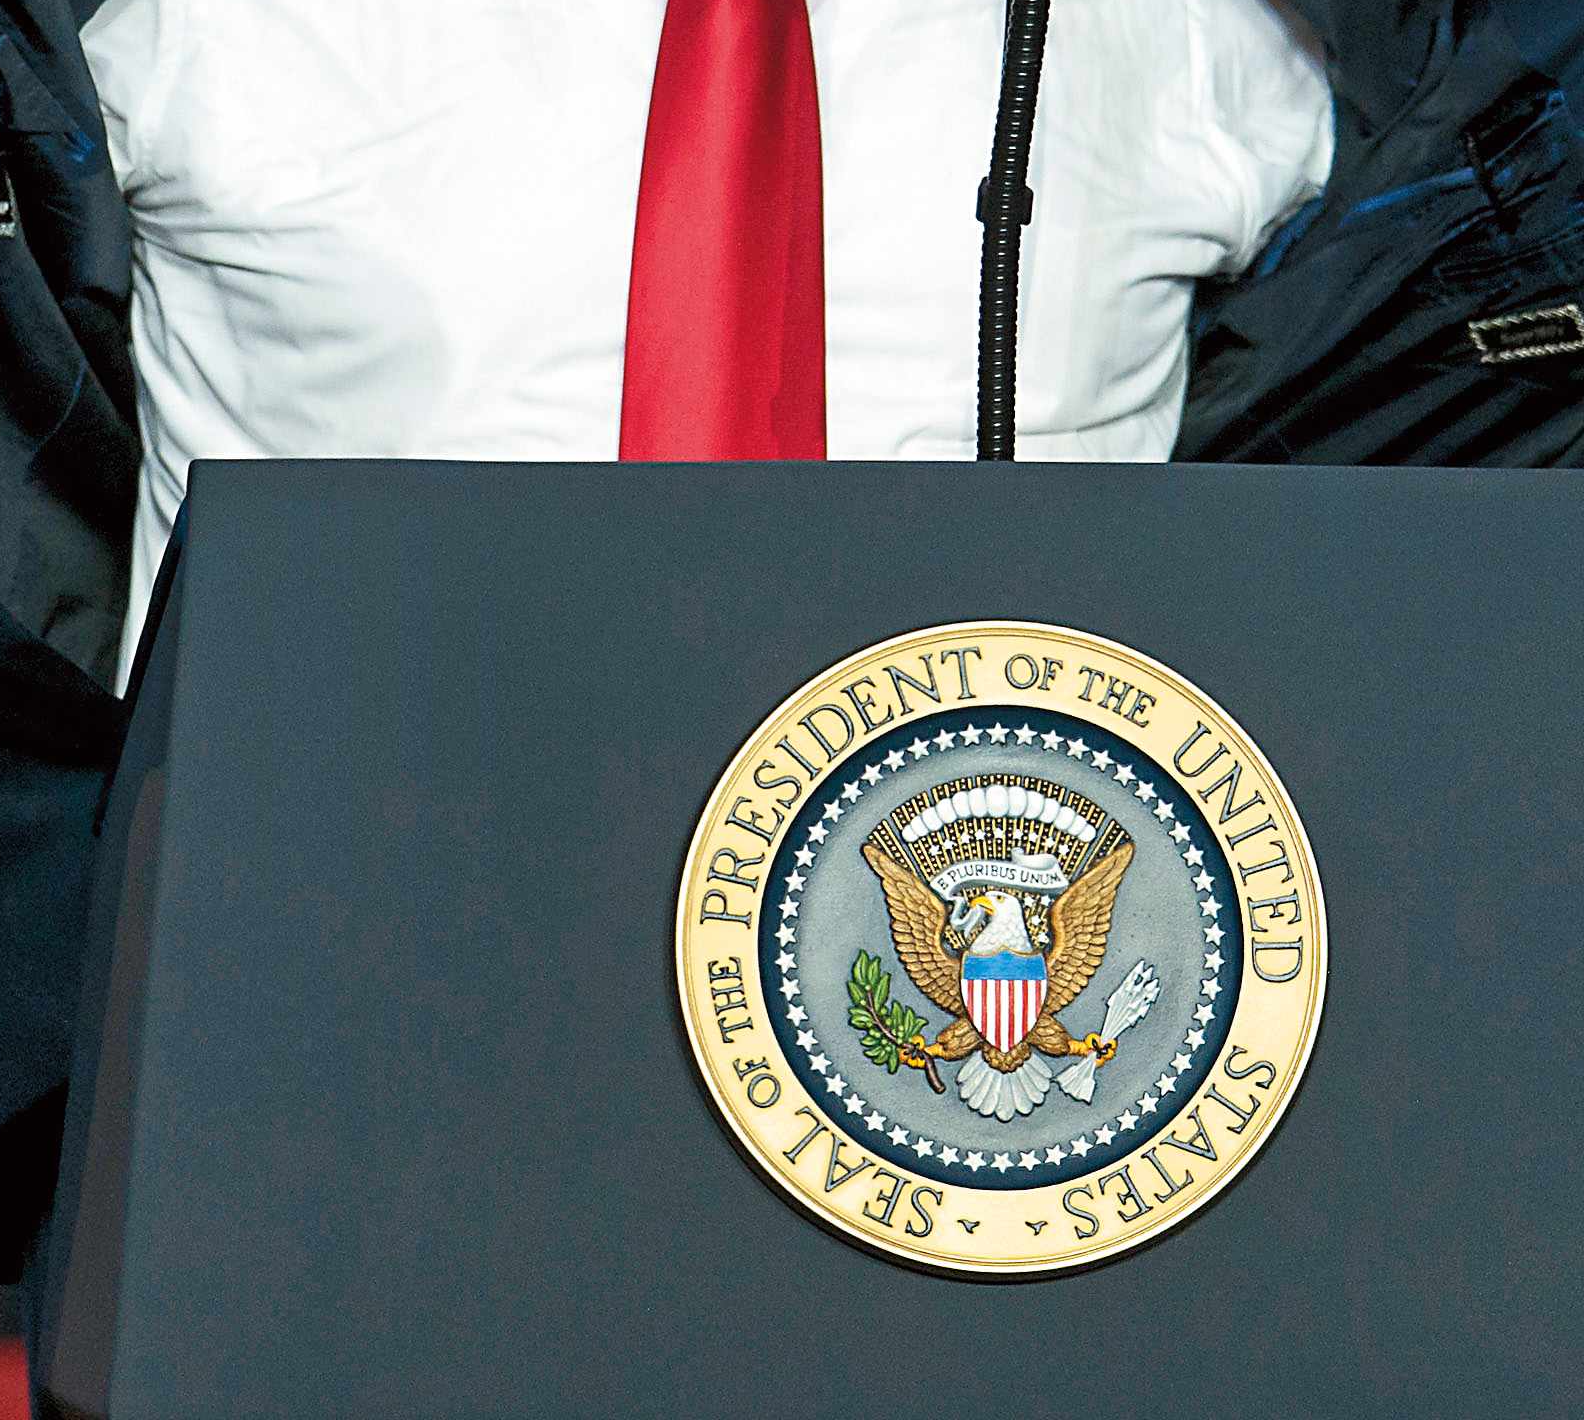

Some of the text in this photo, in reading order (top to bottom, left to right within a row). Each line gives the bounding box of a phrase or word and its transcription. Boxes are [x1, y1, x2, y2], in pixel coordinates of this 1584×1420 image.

[699, 647, 1303, 1240] SEAL OF THE PRESIDENT OF THE UNITED STATES
[937, 864, 1061, 890] E PLURIBUS UNUM
